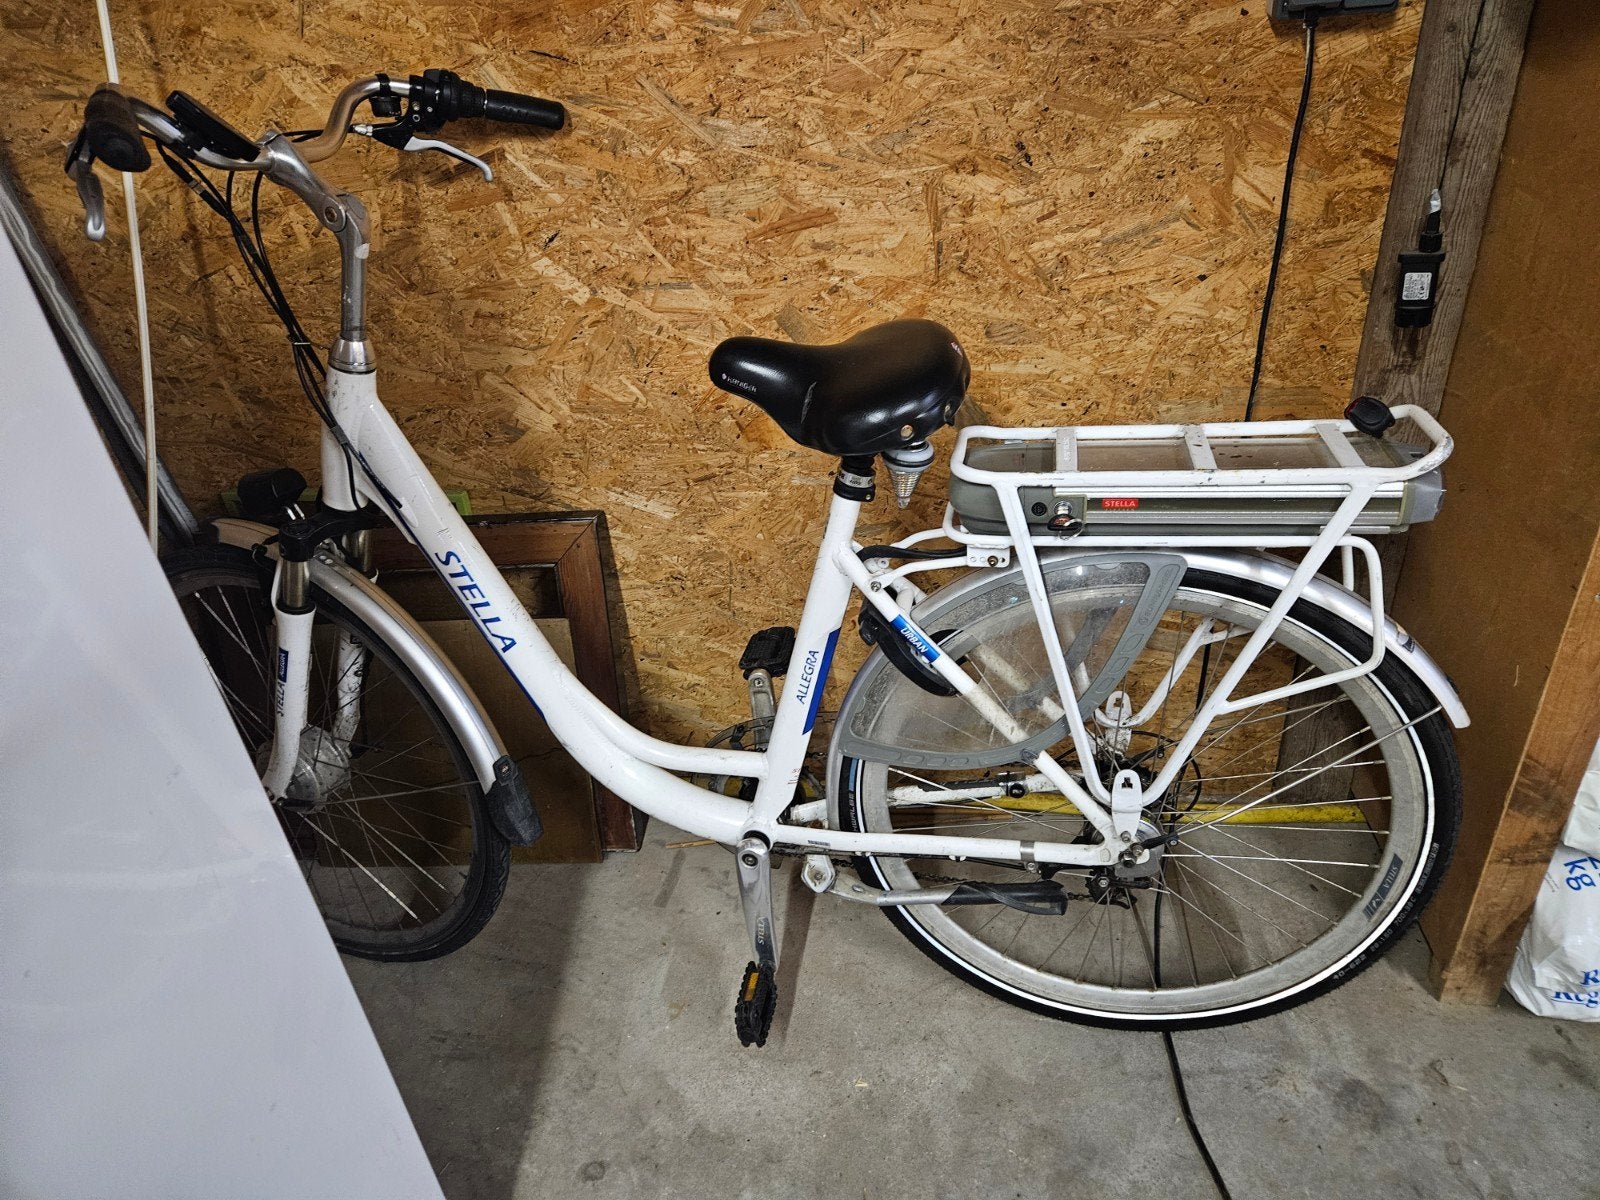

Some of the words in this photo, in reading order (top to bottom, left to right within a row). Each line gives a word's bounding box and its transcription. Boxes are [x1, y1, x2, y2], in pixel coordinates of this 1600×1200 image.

[435, 550, 517, 653] STELLA
[900, 627, 929, 654] URBAN
[277, 681, 287, 717] STELLA
[796, 650, 820, 704] ALLEGRA
